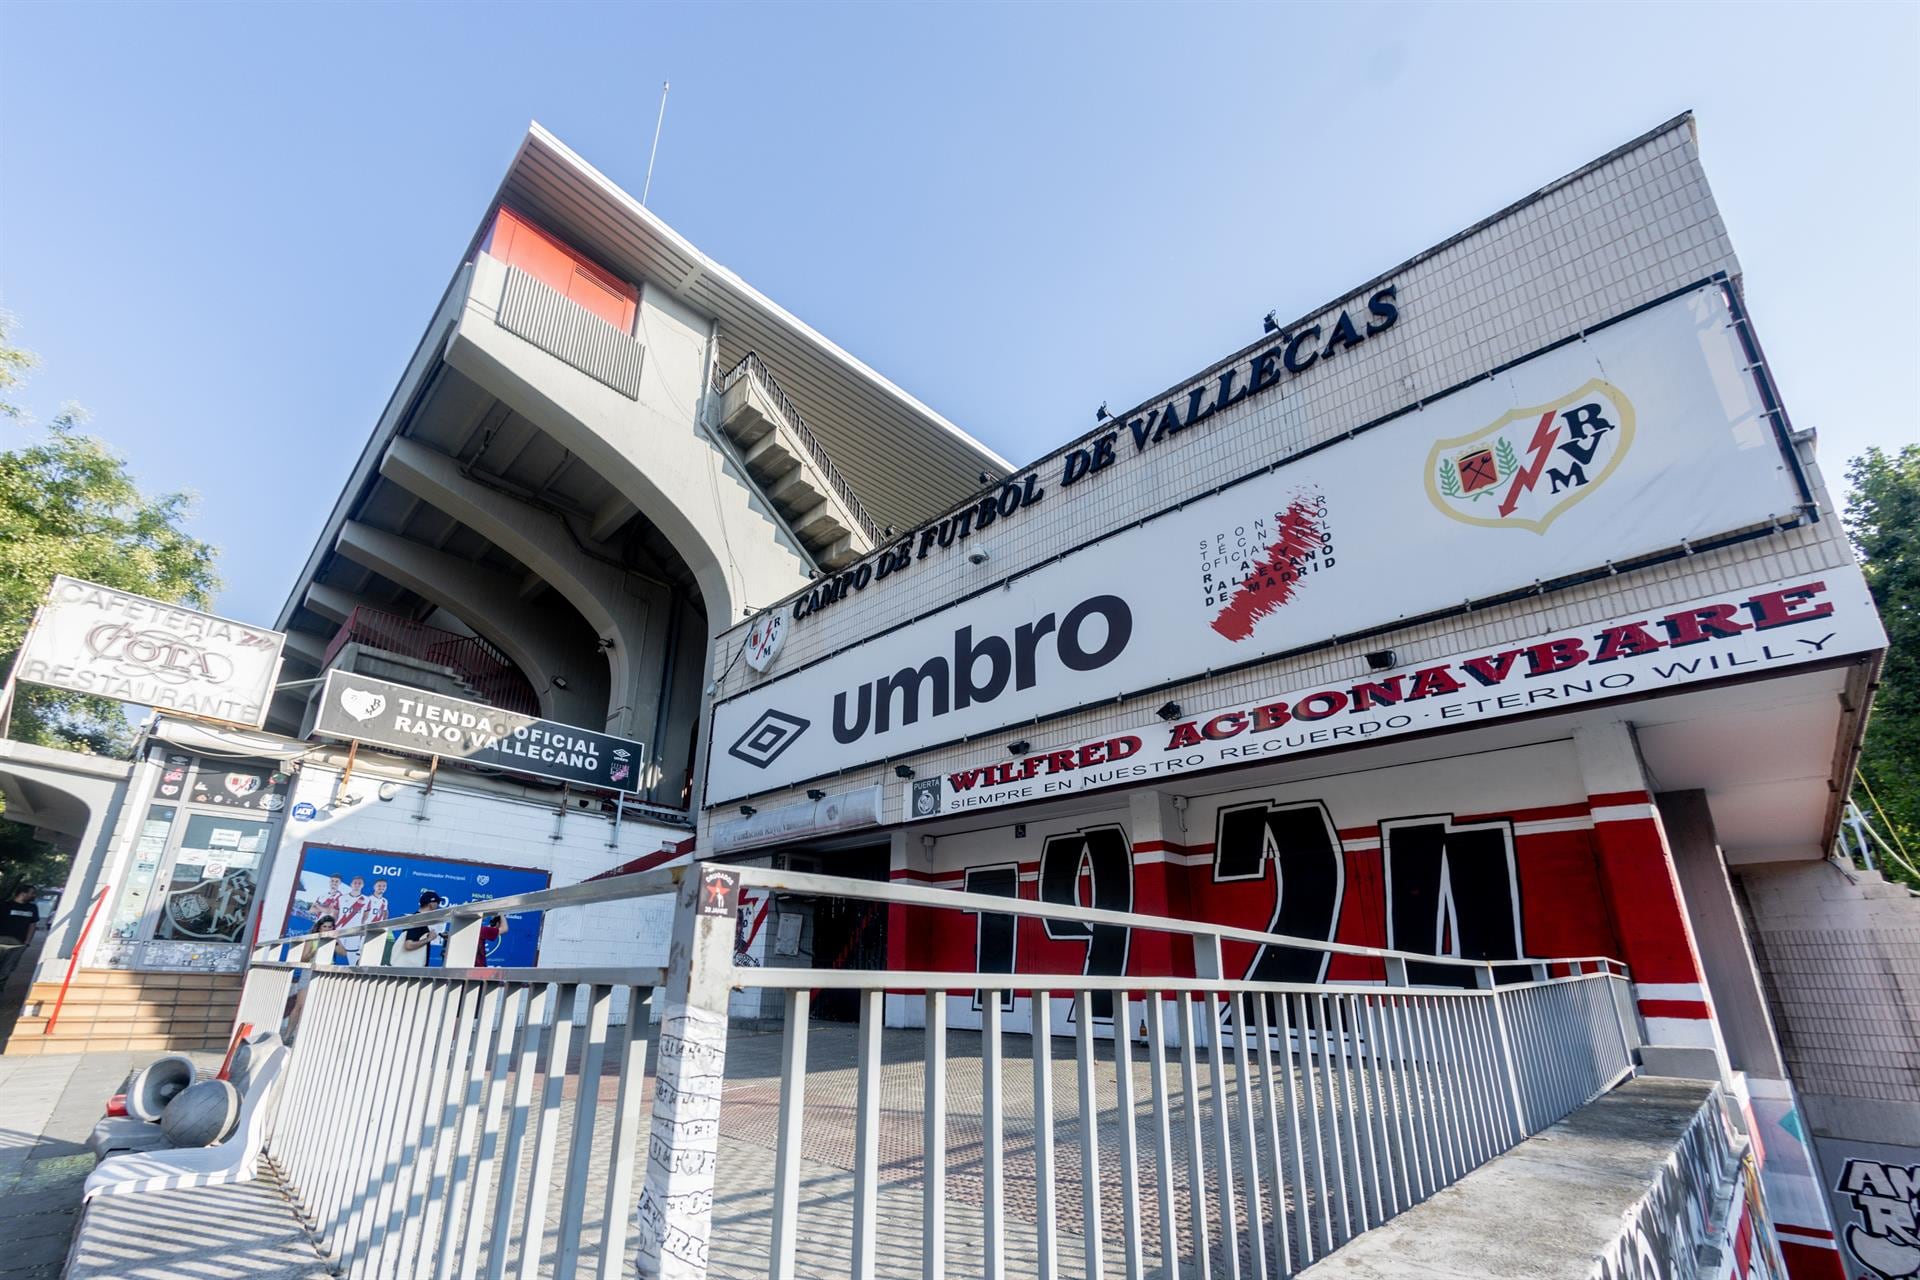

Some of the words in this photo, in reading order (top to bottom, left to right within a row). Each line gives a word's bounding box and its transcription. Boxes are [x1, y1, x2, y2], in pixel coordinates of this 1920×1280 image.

[793, 563, 871, 621] CAMPO
[874, 535, 915, 582] DE
[916, 472, 1045, 560] FUTBOL
[1060, 432, 1118, 487] DE
[1128, 284, 1399, 452] VALLECAS
[1201, 541, 1270, 572] OFICIAL
[1203, 544, 1334, 595] VALLECANO
[1205, 591, 1229, 608] DE
[1247, 557, 1336, 593] MADRID
[57, 582, 233, 642] CAFETERIA
[25, 657, 260, 721] RESTAURANTE
[832, 594, 1132, 745] umbro
[947, 735, 1143, 793] WILFRED
[1164, 581, 1835, 751] AGBONAVBARE
[394, 715, 461, 744] RAYO
[471, 732, 599, 771] VALLECANO
[398, 698, 491, 732] TIENDA
[514, 725, 600, 756] OFICIAL
[951, 786, 1033, 810] SIEMPRE
[1044, 779, 1072, 793] EN
[1083, 754, 1205, 790] NUESTRO
[1219, 714, 1412, 760] RECUERDO
[1441, 673, 1635, 719] ETERNO
[1651, 631, 1837, 679] WILLY
[913, 778, 940, 791] PUERTA
[372, 864, 402, 877] DIGI
